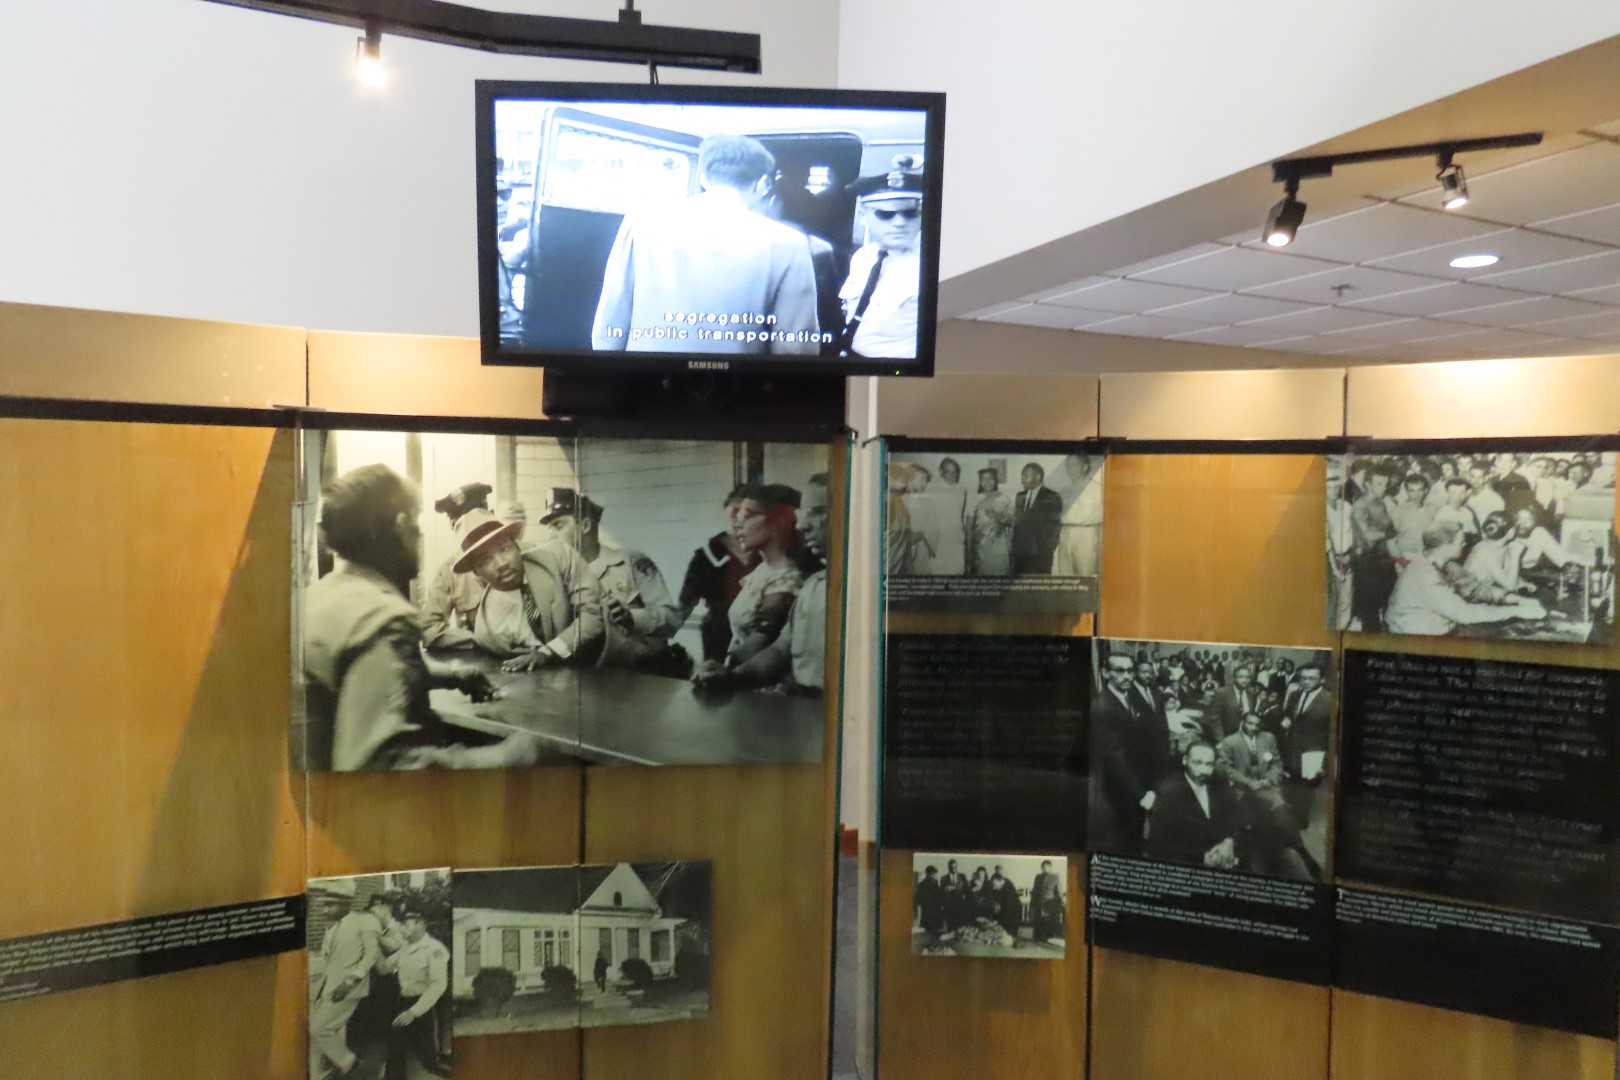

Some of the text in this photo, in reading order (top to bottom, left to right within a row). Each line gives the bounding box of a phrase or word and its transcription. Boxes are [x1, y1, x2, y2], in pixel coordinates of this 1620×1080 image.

[664, 311, 777, 326] segregation
[607, 325, 833, 344] in public transportation
[688, 360, 730, 370] SAMSUNG
